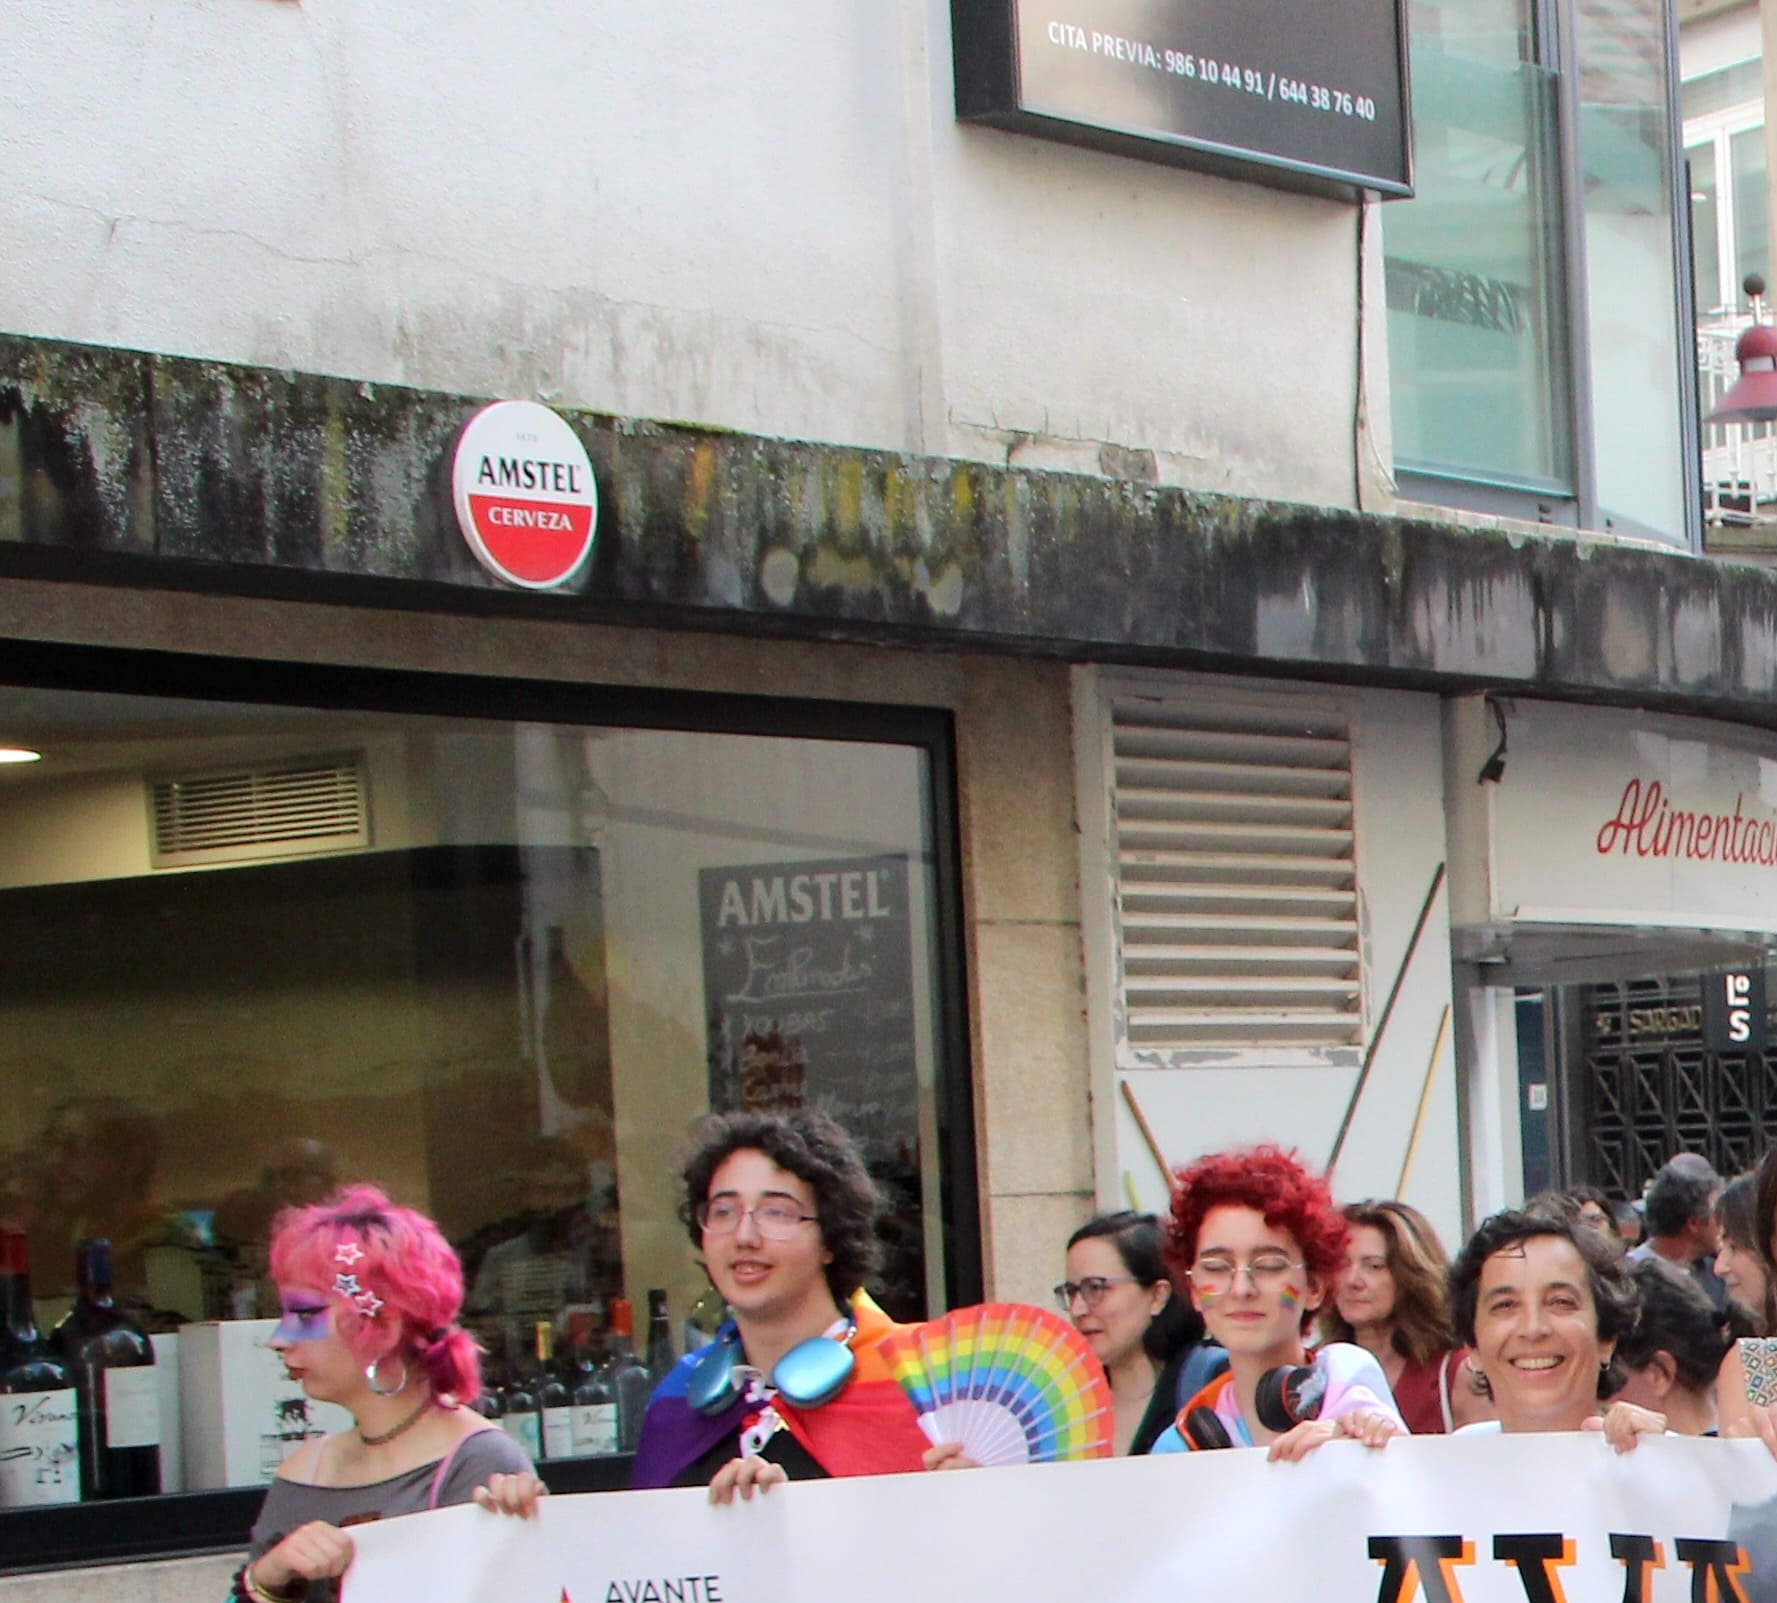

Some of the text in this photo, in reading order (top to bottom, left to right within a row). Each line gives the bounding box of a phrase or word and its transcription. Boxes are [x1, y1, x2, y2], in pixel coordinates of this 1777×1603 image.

[1048, 20, 1375, 121] CITA PREVIA: 986 10 44 91 / 644 38 76 40
[478, 455, 583, 494] AMSTEL
[488, 506, 573, 532] CERVEZA
[718, 870, 891, 928] AMSTEL
